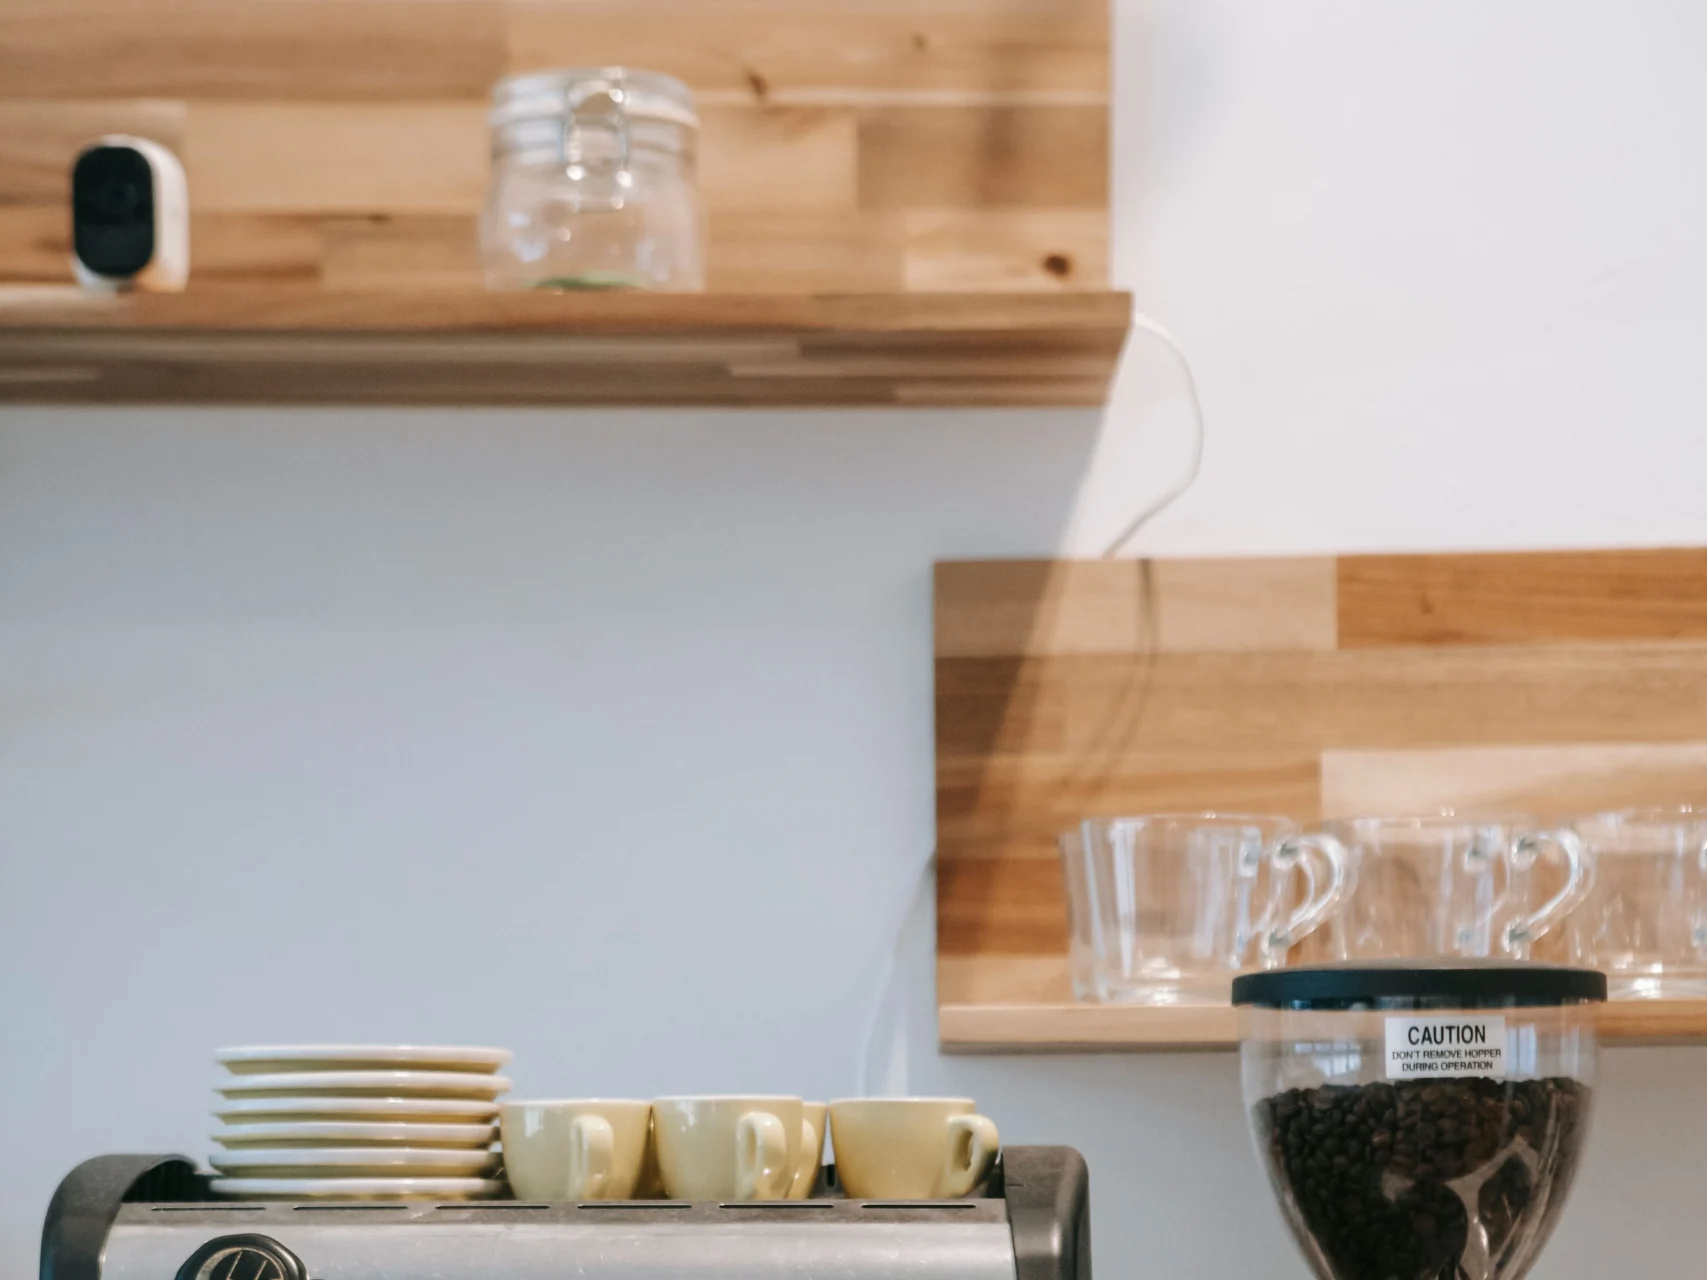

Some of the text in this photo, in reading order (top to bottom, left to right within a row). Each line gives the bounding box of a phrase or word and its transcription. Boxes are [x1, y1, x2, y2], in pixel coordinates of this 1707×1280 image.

[1408, 1025, 1486, 1045] CAUTION
[1392, 1048, 1502, 1060] DON'T REMOVE HOPPER
[1402, 1061, 1493, 1072] DURING OPERATION
